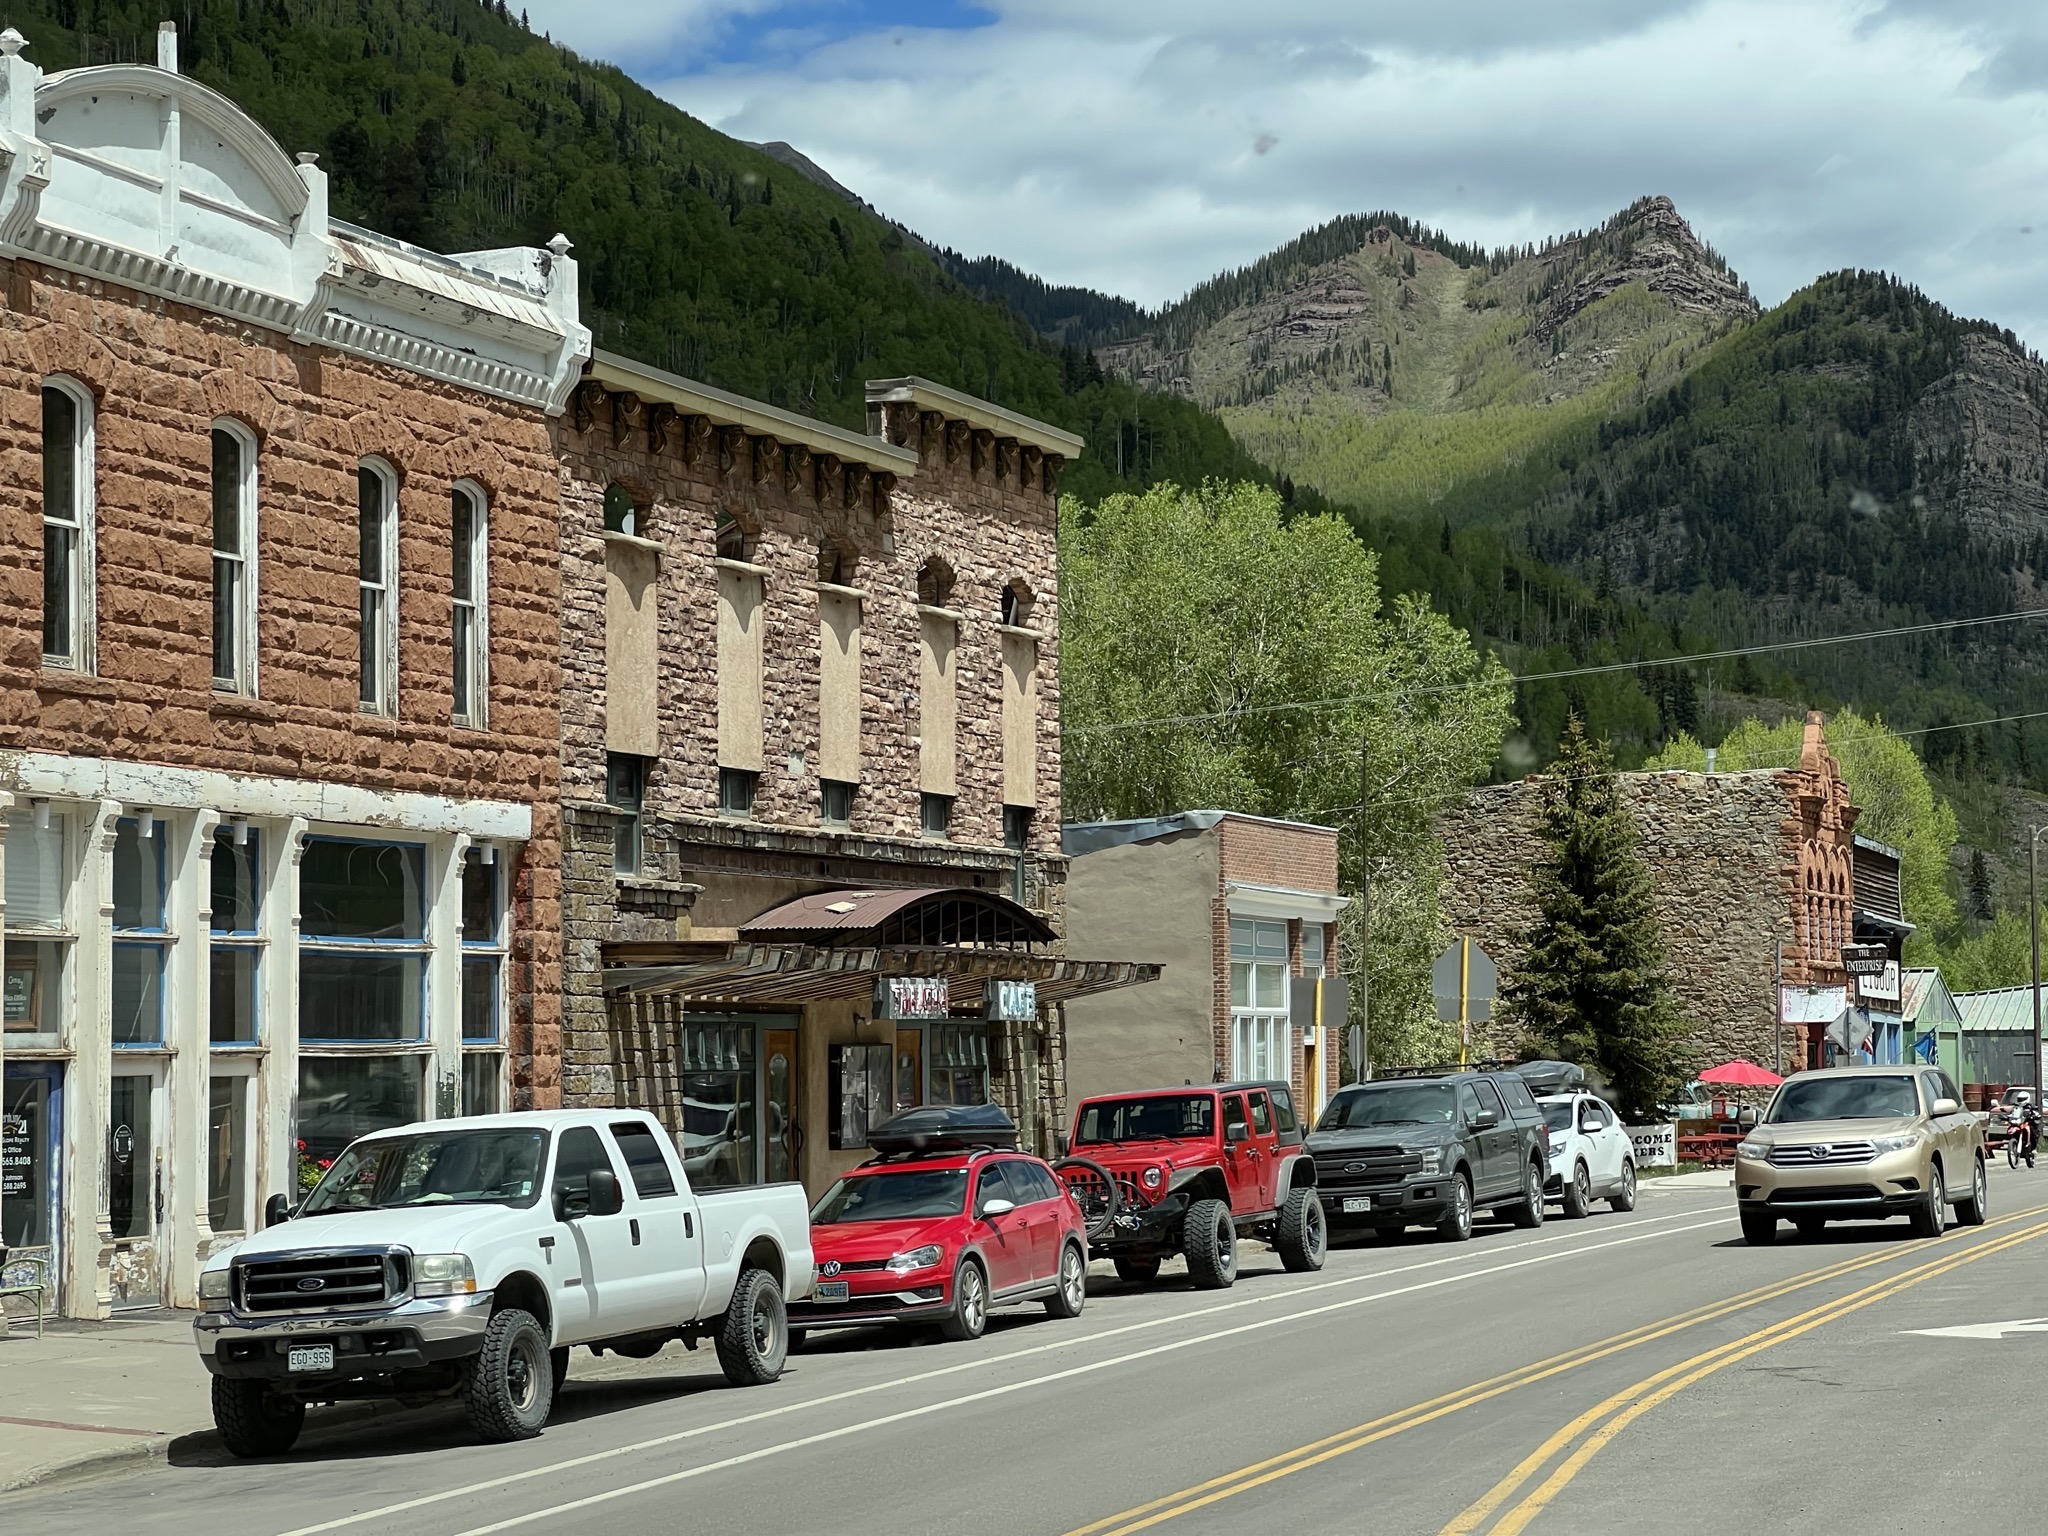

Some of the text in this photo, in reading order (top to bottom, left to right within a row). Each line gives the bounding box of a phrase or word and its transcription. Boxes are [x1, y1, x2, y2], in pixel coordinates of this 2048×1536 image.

[1858, 949, 1870, 957] THE
[1847, 960, 1883, 972] ENTERPRISE
[1629, 1134, 1671, 1144] COME
